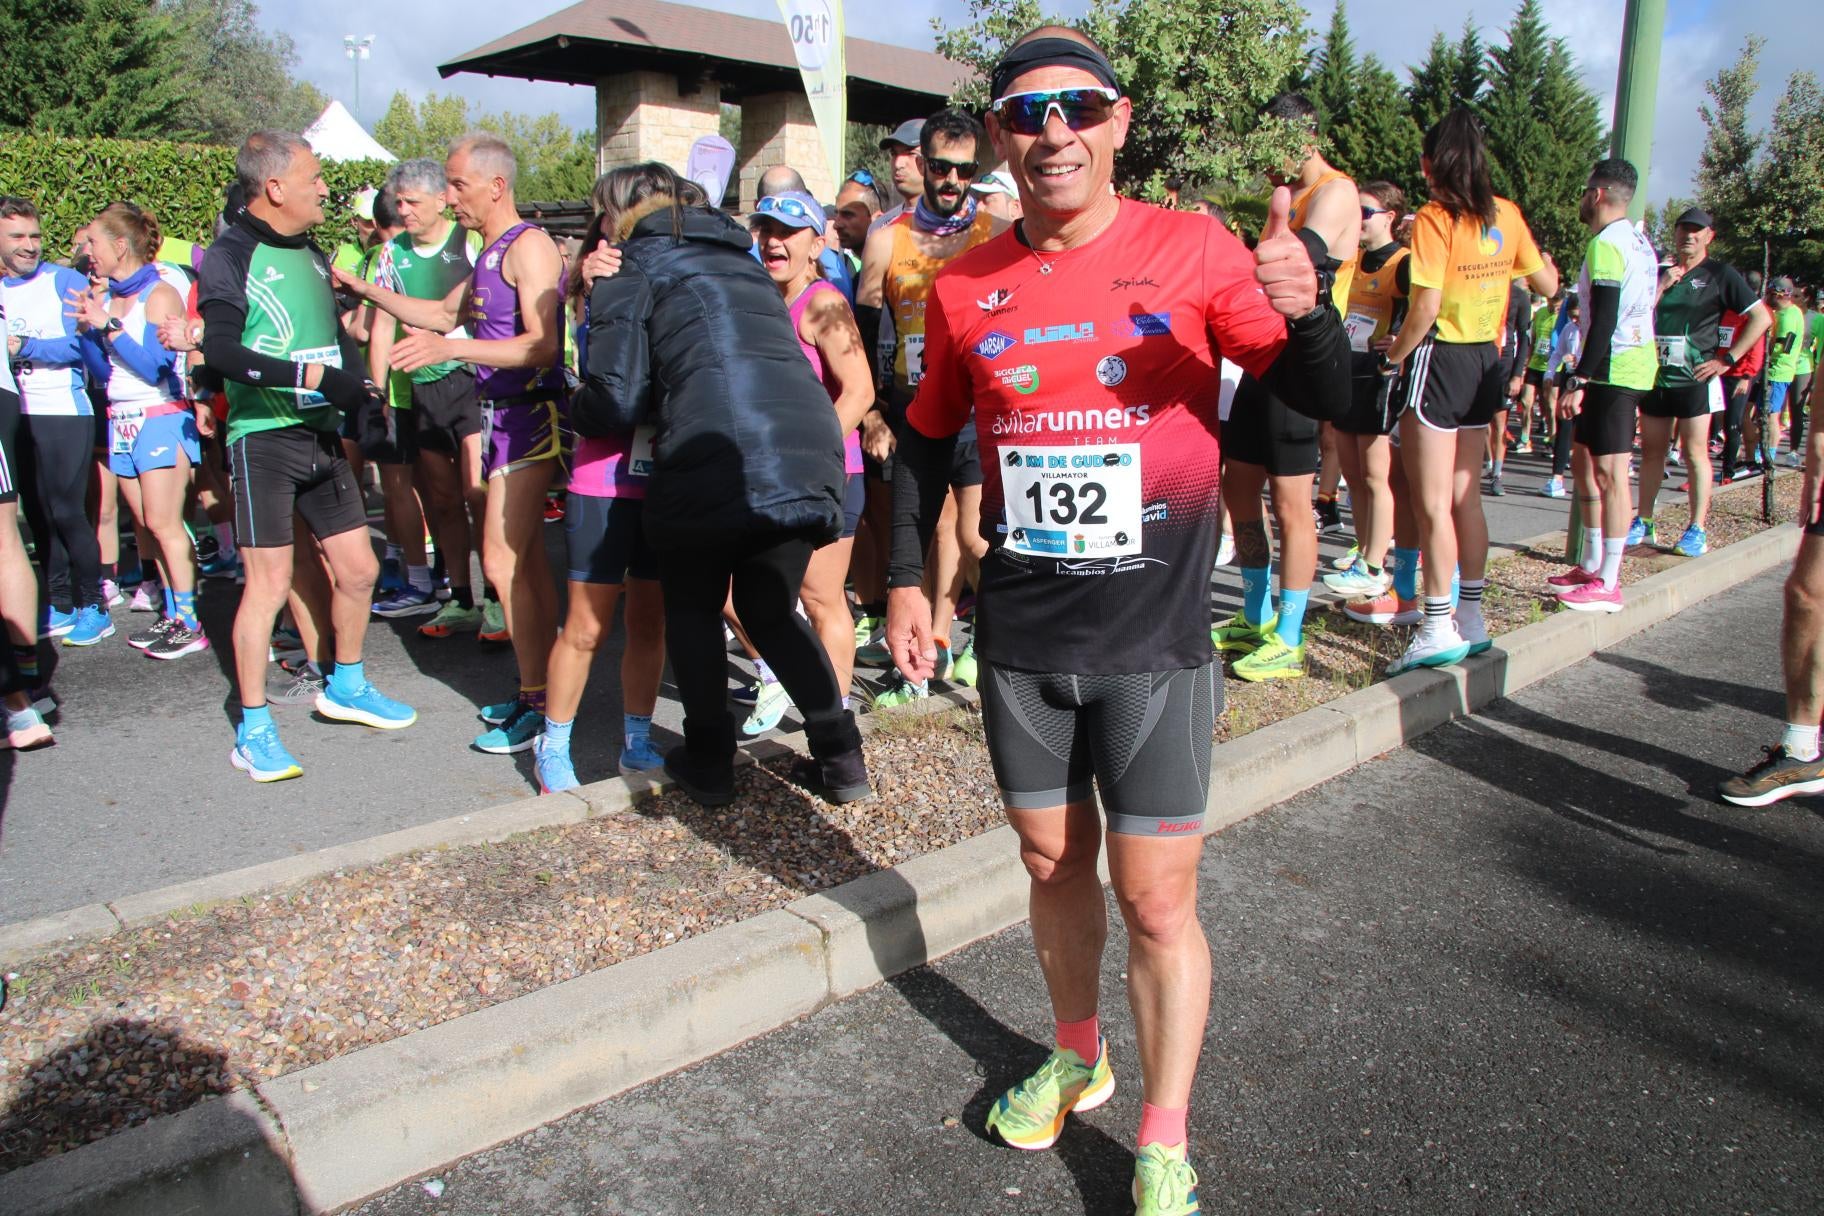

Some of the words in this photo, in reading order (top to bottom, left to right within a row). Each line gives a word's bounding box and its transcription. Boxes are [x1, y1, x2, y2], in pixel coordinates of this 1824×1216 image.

[979, 336, 1005, 355] MARSAN
[1026, 455, 1044, 468] KM
[1048, 455, 1068, 468] DE
[1026, 481, 1108, 525] 132
